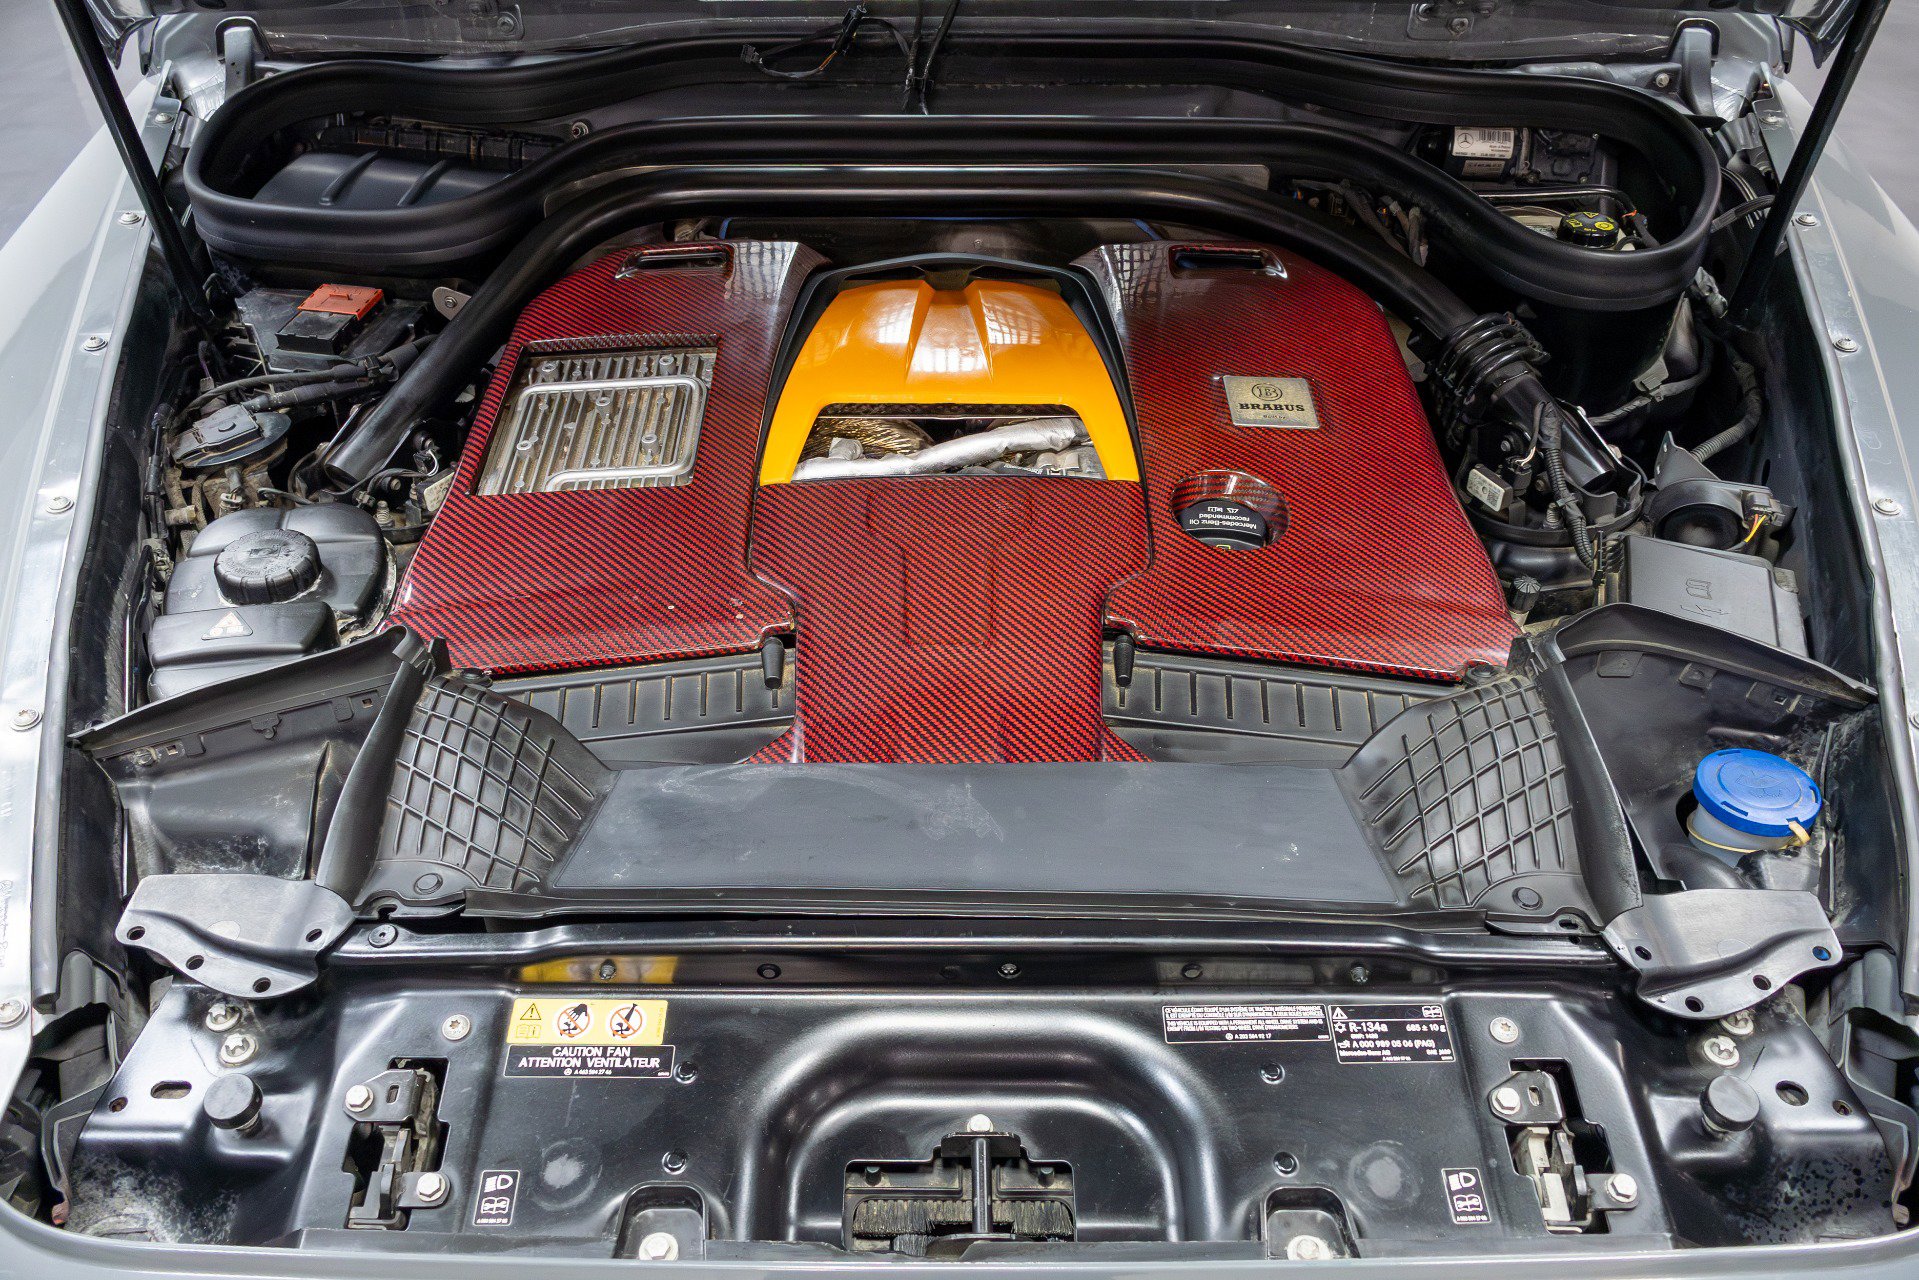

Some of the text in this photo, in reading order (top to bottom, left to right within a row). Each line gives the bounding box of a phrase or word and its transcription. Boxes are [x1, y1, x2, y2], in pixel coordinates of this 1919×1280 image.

[1239, 403, 1305, 411] BRABUS
[1199, 513, 1250, 522] recommended
[1201, 519, 1257, 529] Mercedes-Benz
[1348, 1022, 1388, 1032] R-134a
[1406, 1024, 1421, 1032] 685
[1429, 1023, 1439, 1031] 10
[1414, 1040, 1436, 1049] (PAG)
[552, 1047, 630, 1057] CAUTION FAN
[518, 1057, 660, 1068] ATTENTION VENTILATEUR
